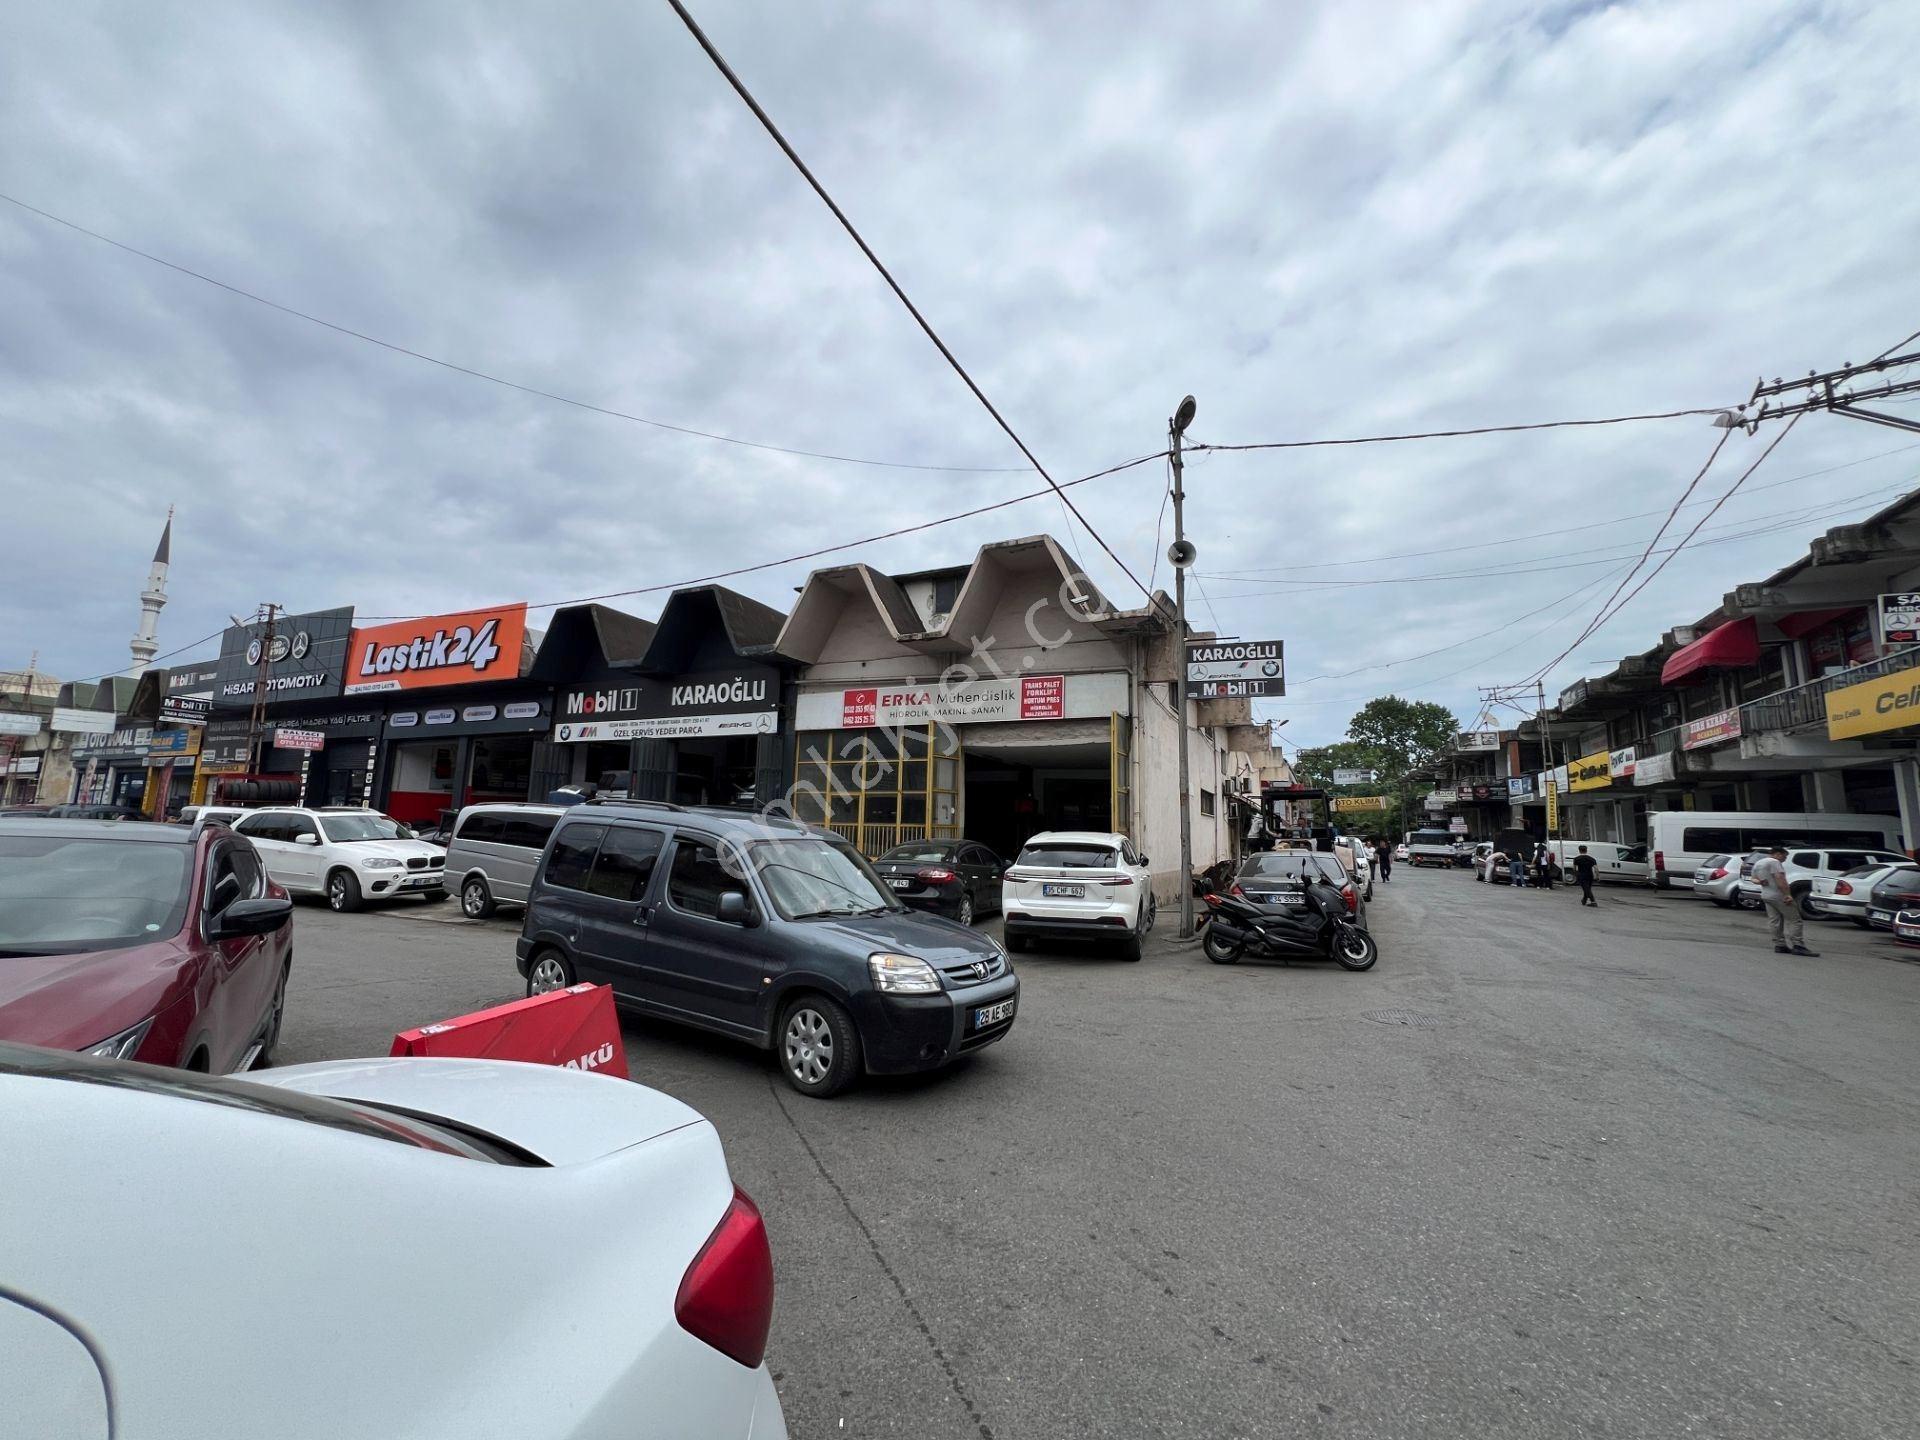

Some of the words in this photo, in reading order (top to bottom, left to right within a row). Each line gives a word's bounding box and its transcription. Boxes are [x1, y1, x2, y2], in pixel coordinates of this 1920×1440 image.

[360, 618, 501, 677] Lastik24
[1192, 643, 1277, 662] KARAOĞLU
[671, 677, 766, 706] KARAOĞLU
[882, 692, 931, 707] ERKA
[936, 689, 1015, 705] Mühendislik
[1203, 681, 1246, 697] Mobil
[164, 698, 195, 710] Mobil
[567, 690, 618, 715] Mobil
[613, 728, 629, 737] ÖZEL
[631, 726, 653, 736] SERVİS
[656, 726, 677, 735] YEDEK
[679, 725, 703, 735] PARÇA
[564, 1042, 613, 1071] AKÜ
